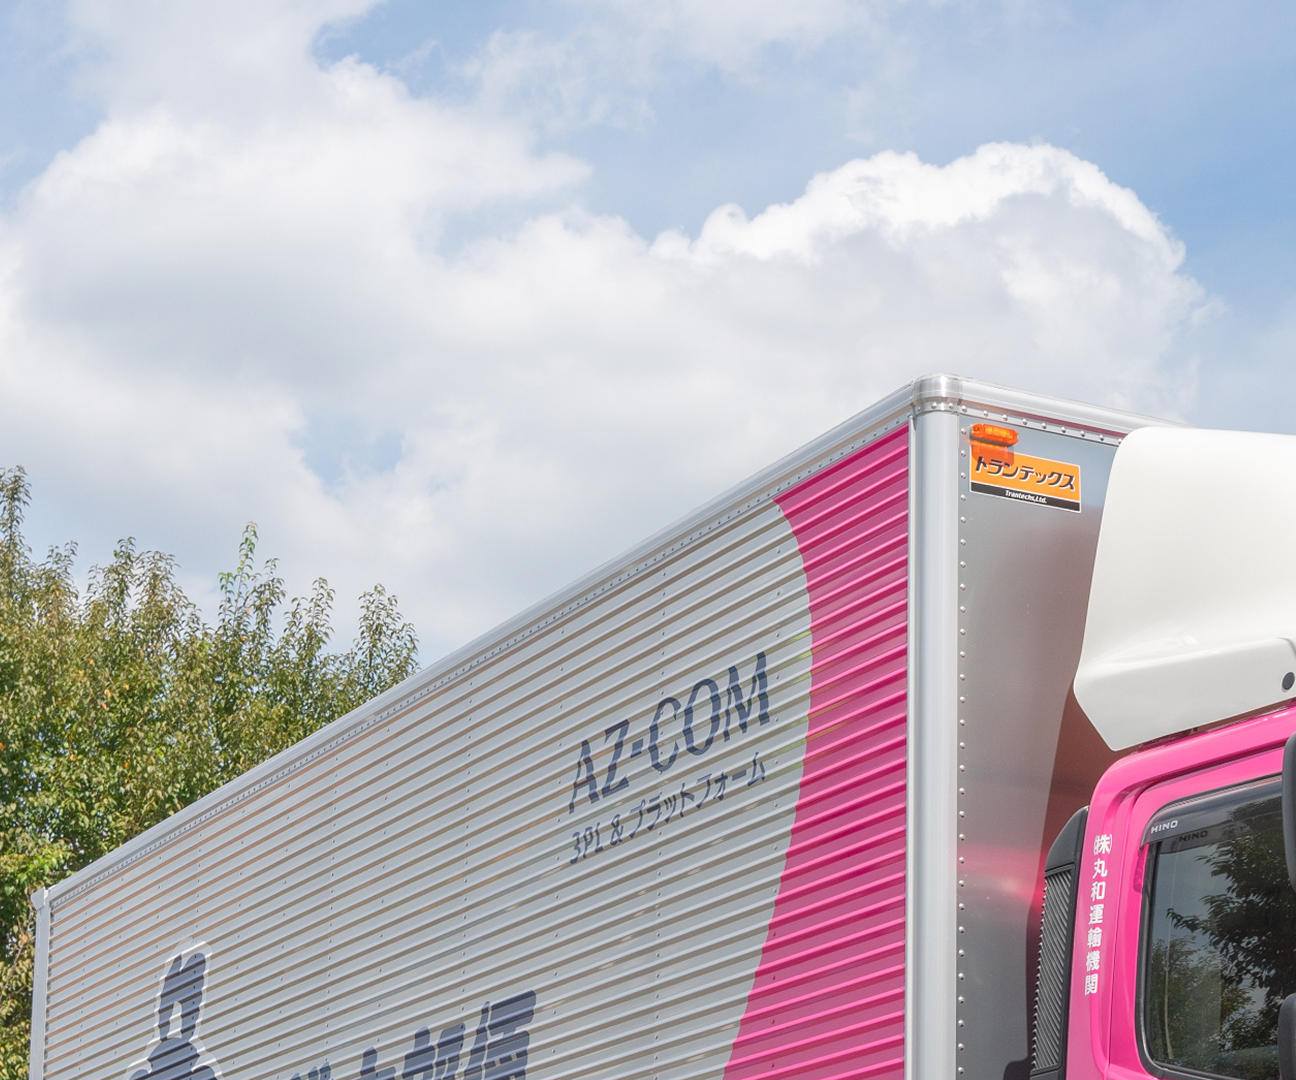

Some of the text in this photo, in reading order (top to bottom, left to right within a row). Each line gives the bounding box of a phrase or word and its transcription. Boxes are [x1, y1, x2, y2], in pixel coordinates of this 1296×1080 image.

[976, 456, 1075, 491] トランテックス
[569, 652, 770, 814] AZ-COM
[570, 752, 766, 864] 3PL & プラットフォーム
[1151, 820, 1178, 834] HINO
